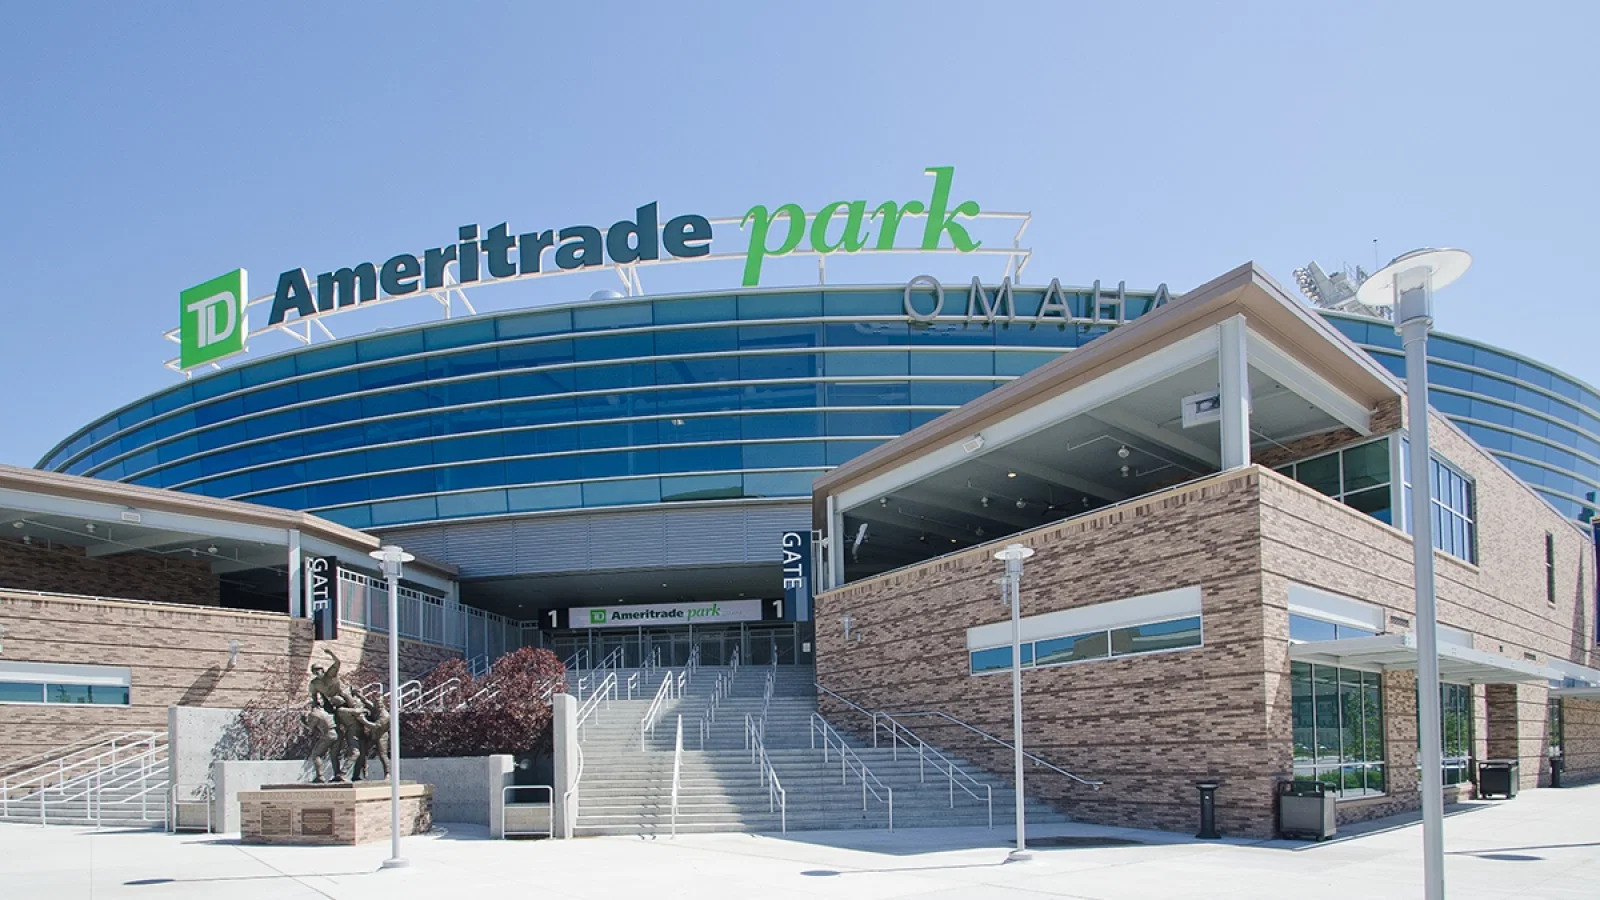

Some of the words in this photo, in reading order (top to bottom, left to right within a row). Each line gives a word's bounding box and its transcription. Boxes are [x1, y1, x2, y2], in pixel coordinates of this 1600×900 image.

[186, 290, 237, 349] TD
[268, 200, 713, 326] Ameritrade
[739, 166, 982, 286] park
[903, 275, 1170, 324] OMAHA
[312, 558, 328, 611] GATE
[783, 532, 802, 588] GATE
[548, 610, 557, 628] 1
[611, 608, 684, 621] Ameritrade
[687, 603, 721, 621] park
[772, 599, 783, 618] 1
